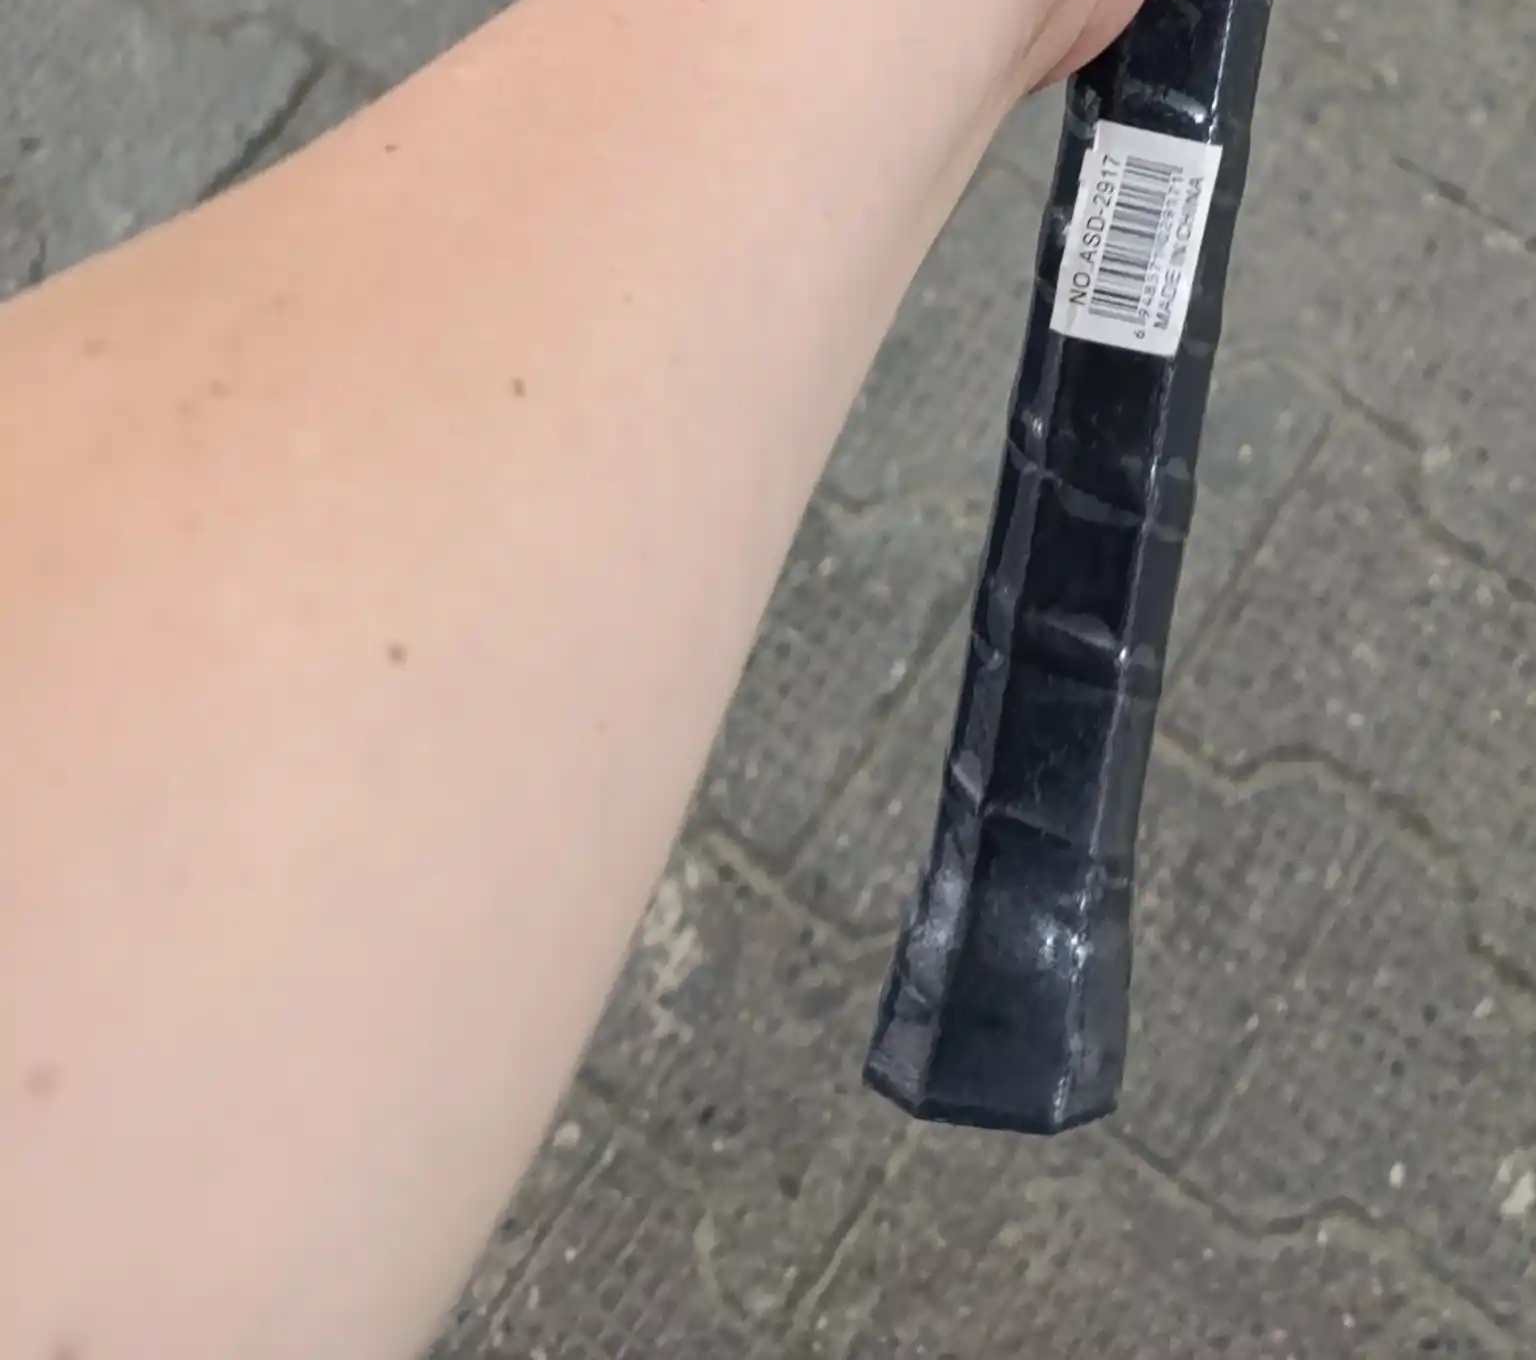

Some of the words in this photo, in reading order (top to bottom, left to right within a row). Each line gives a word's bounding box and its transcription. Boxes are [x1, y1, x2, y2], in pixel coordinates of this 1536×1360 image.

[1176, 176, 1204, 240] CHINA
[1169, 241, 1188, 266] IN
[1153, 267, 1181, 330] MADE
